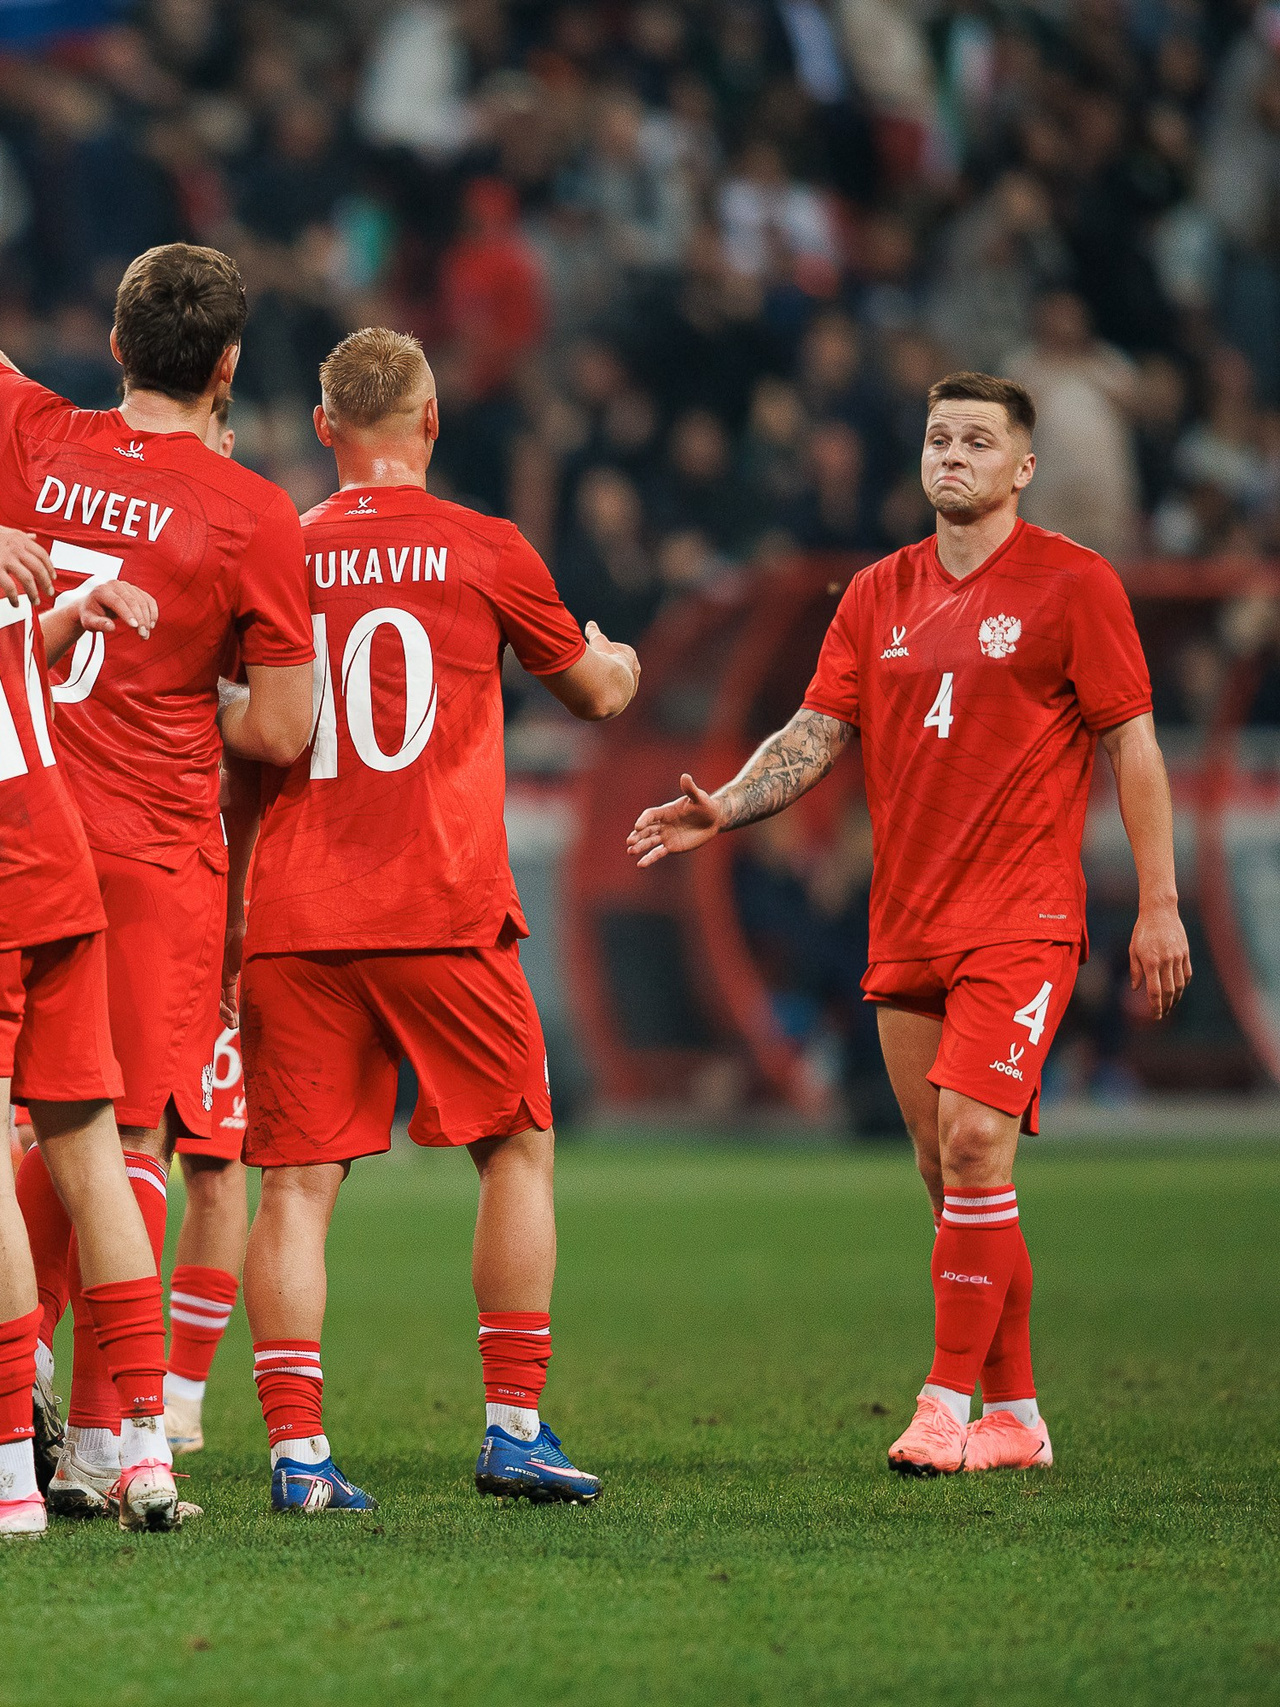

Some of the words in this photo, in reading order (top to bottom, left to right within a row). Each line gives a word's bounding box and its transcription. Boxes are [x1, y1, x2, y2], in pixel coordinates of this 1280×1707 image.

[35, 475, 174, 542] DIVEEV
[880, 646, 910, 659] JOGEL
[307, 607, 438, 780] 10
[923, 672, 954, 738] 4
[1013, 980, 1053, 1046] 4
[212, 1026, 242, 1090] 6
[989, 1060, 1023, 1082] JOGEL
[940, 1270, 992, 1285] JOGEL
